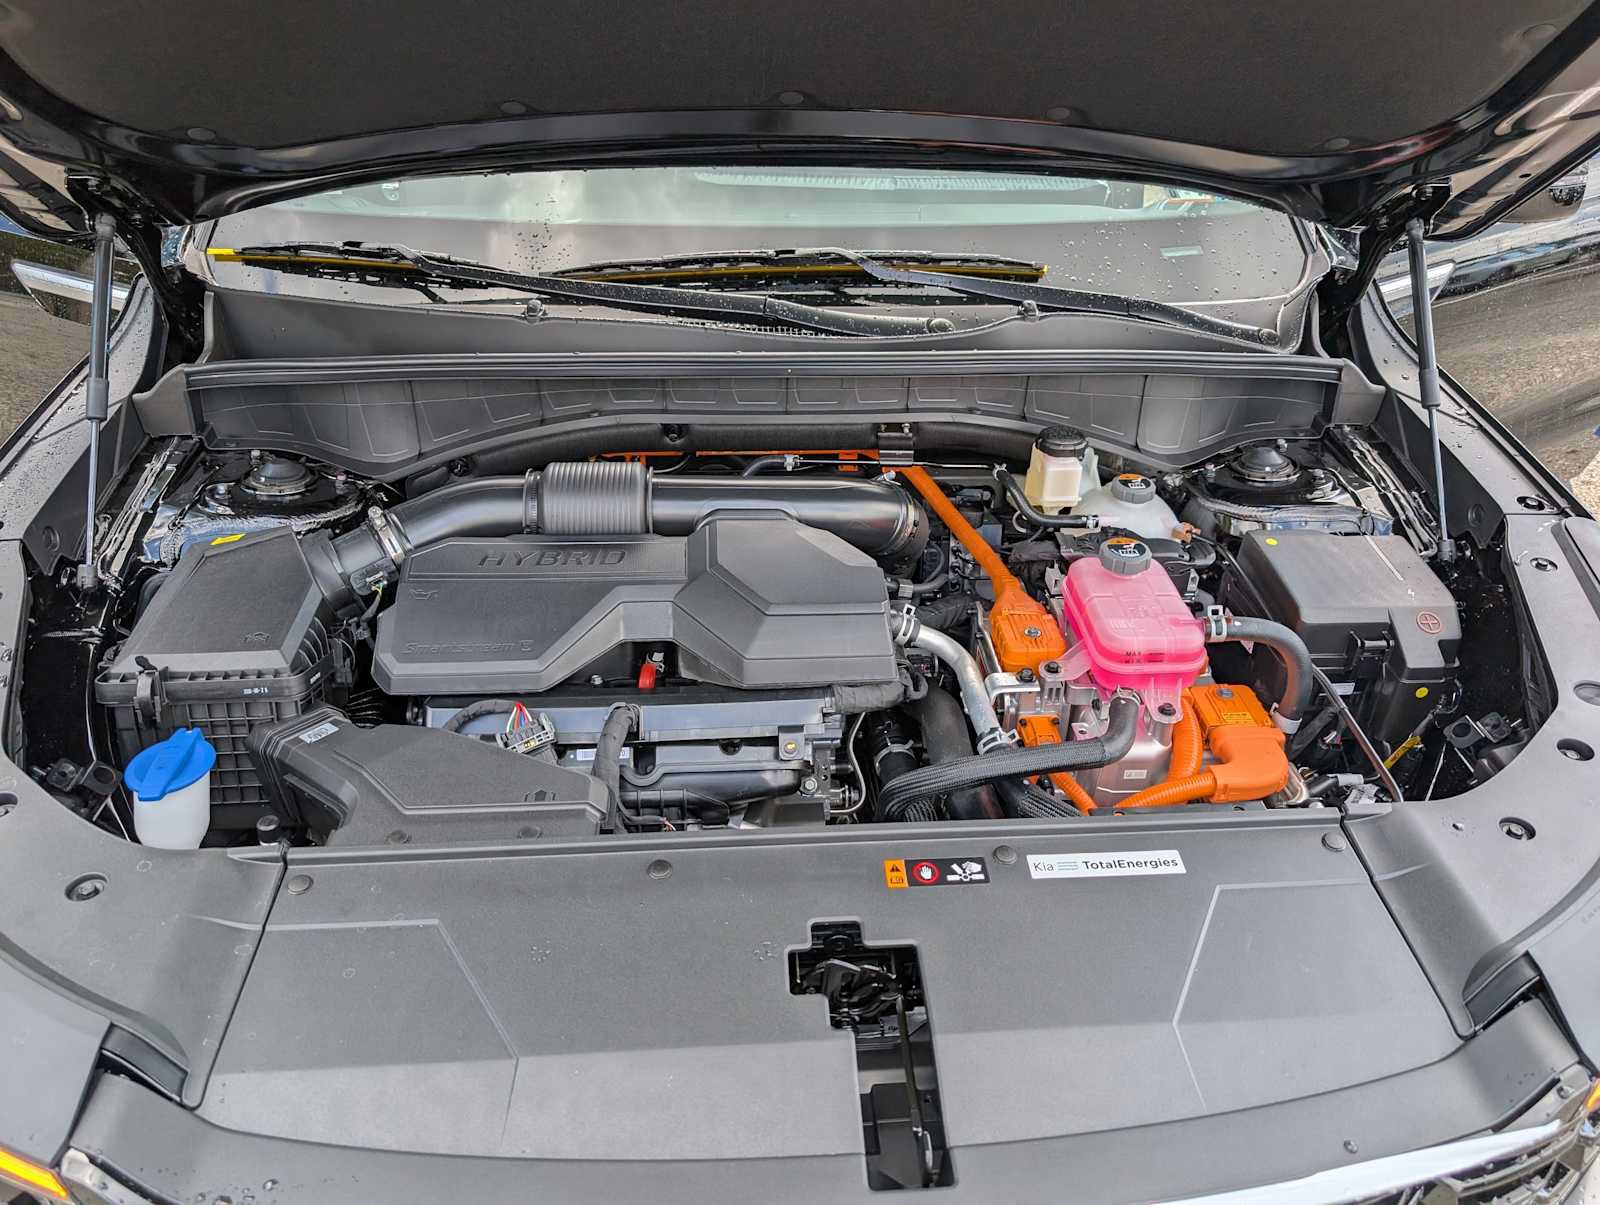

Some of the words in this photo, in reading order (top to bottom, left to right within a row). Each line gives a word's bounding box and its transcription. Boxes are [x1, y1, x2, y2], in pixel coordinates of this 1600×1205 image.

[478, 550, 626, 567] HYBRID
[1032, 861, 1054, 872] Kia
[1082, 857, 1178, 870] TotalEnergies
